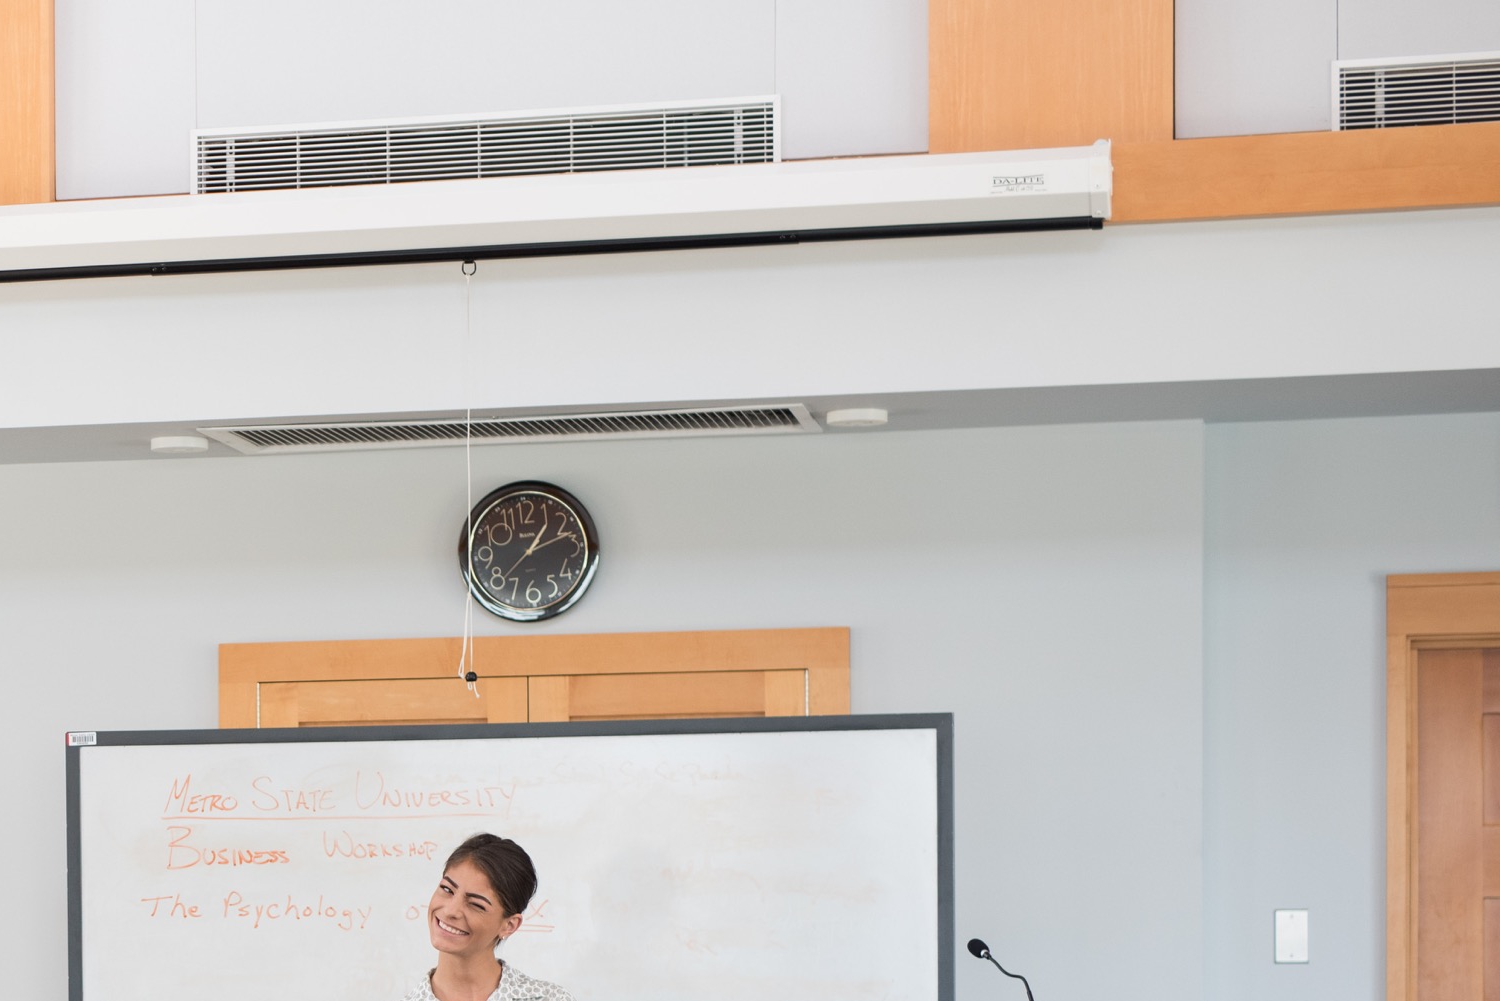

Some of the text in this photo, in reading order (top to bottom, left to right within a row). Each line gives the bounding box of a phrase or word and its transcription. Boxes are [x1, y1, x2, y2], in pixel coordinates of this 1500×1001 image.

[993, 177, 1044, 185] DA-LITE
[500, 508, 515, 530] 11
[516, 500, 535, 524] 12
[556, 512, 569, 536] 2
[484, 525, 512, 546] 10
[568, 534, 580, 558] 3
[478, 546, 493, 570] 9
[560, 558, 572, 580] 4
[490, 567, 506, 590] 8
[509, 578, 518, 600] 7
[546, 574, 558, 598] 5
[526, 580, 542, 604] 6
[164, 774, 238, 813] METRO
[252, 776, 336, 812] STATE
[356, 770, 516, 820] UNIVERSITY
[166, 826, 438, 870] BUSINESS WORKSHOP
[141, 894, 202, 918] The
[224, 891, 372, 930] Psychology
